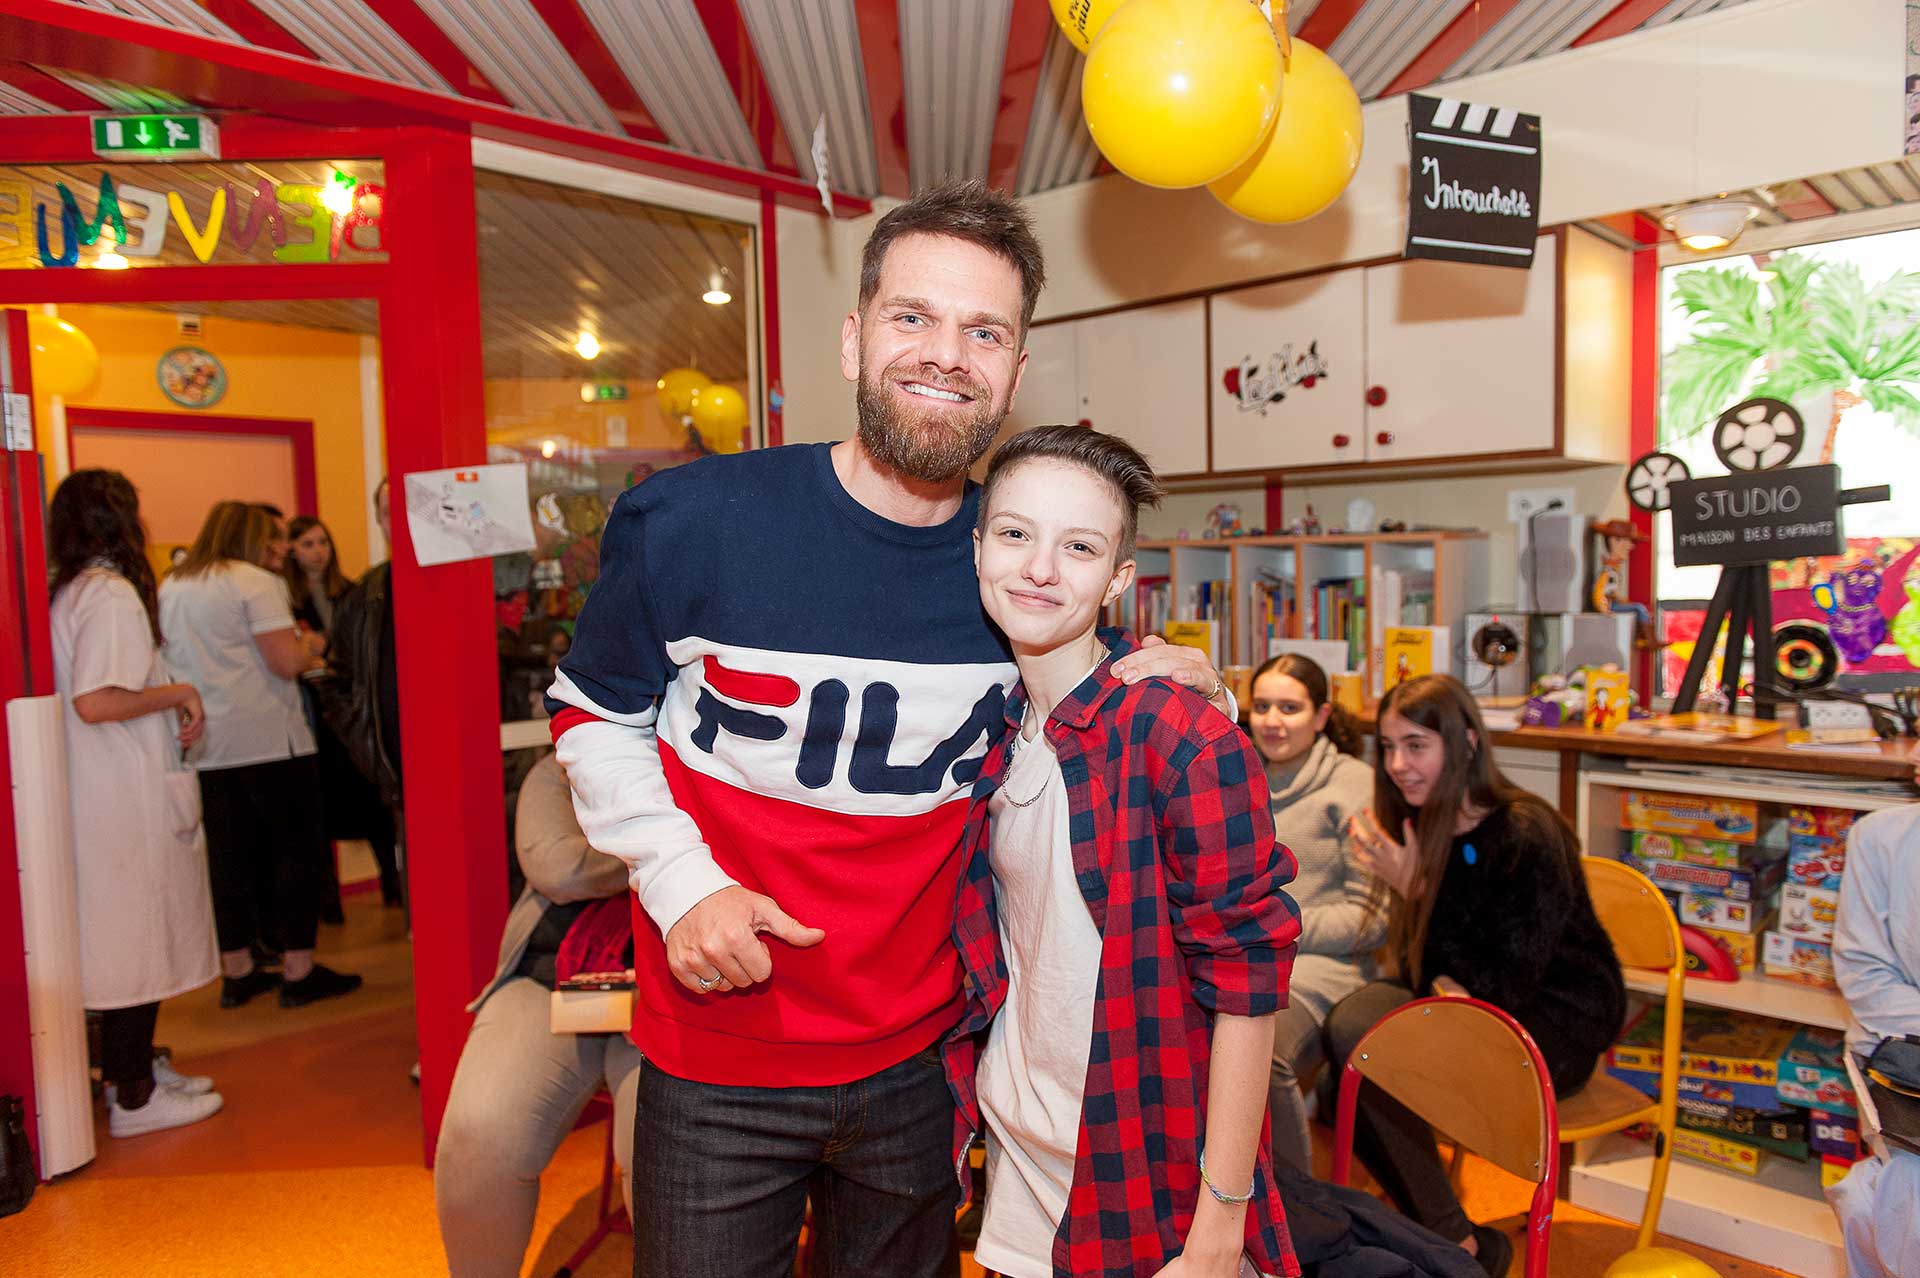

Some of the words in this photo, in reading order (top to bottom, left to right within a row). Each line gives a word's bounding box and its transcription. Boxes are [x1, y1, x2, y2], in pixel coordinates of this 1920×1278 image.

[1695, 485, 1801, 520] STUDIO
[1679, 530, 1735, 546] MAISON
[1744, 526, 1771, 542] DES
[1776, 521, 1834, 539] ENFANTS
